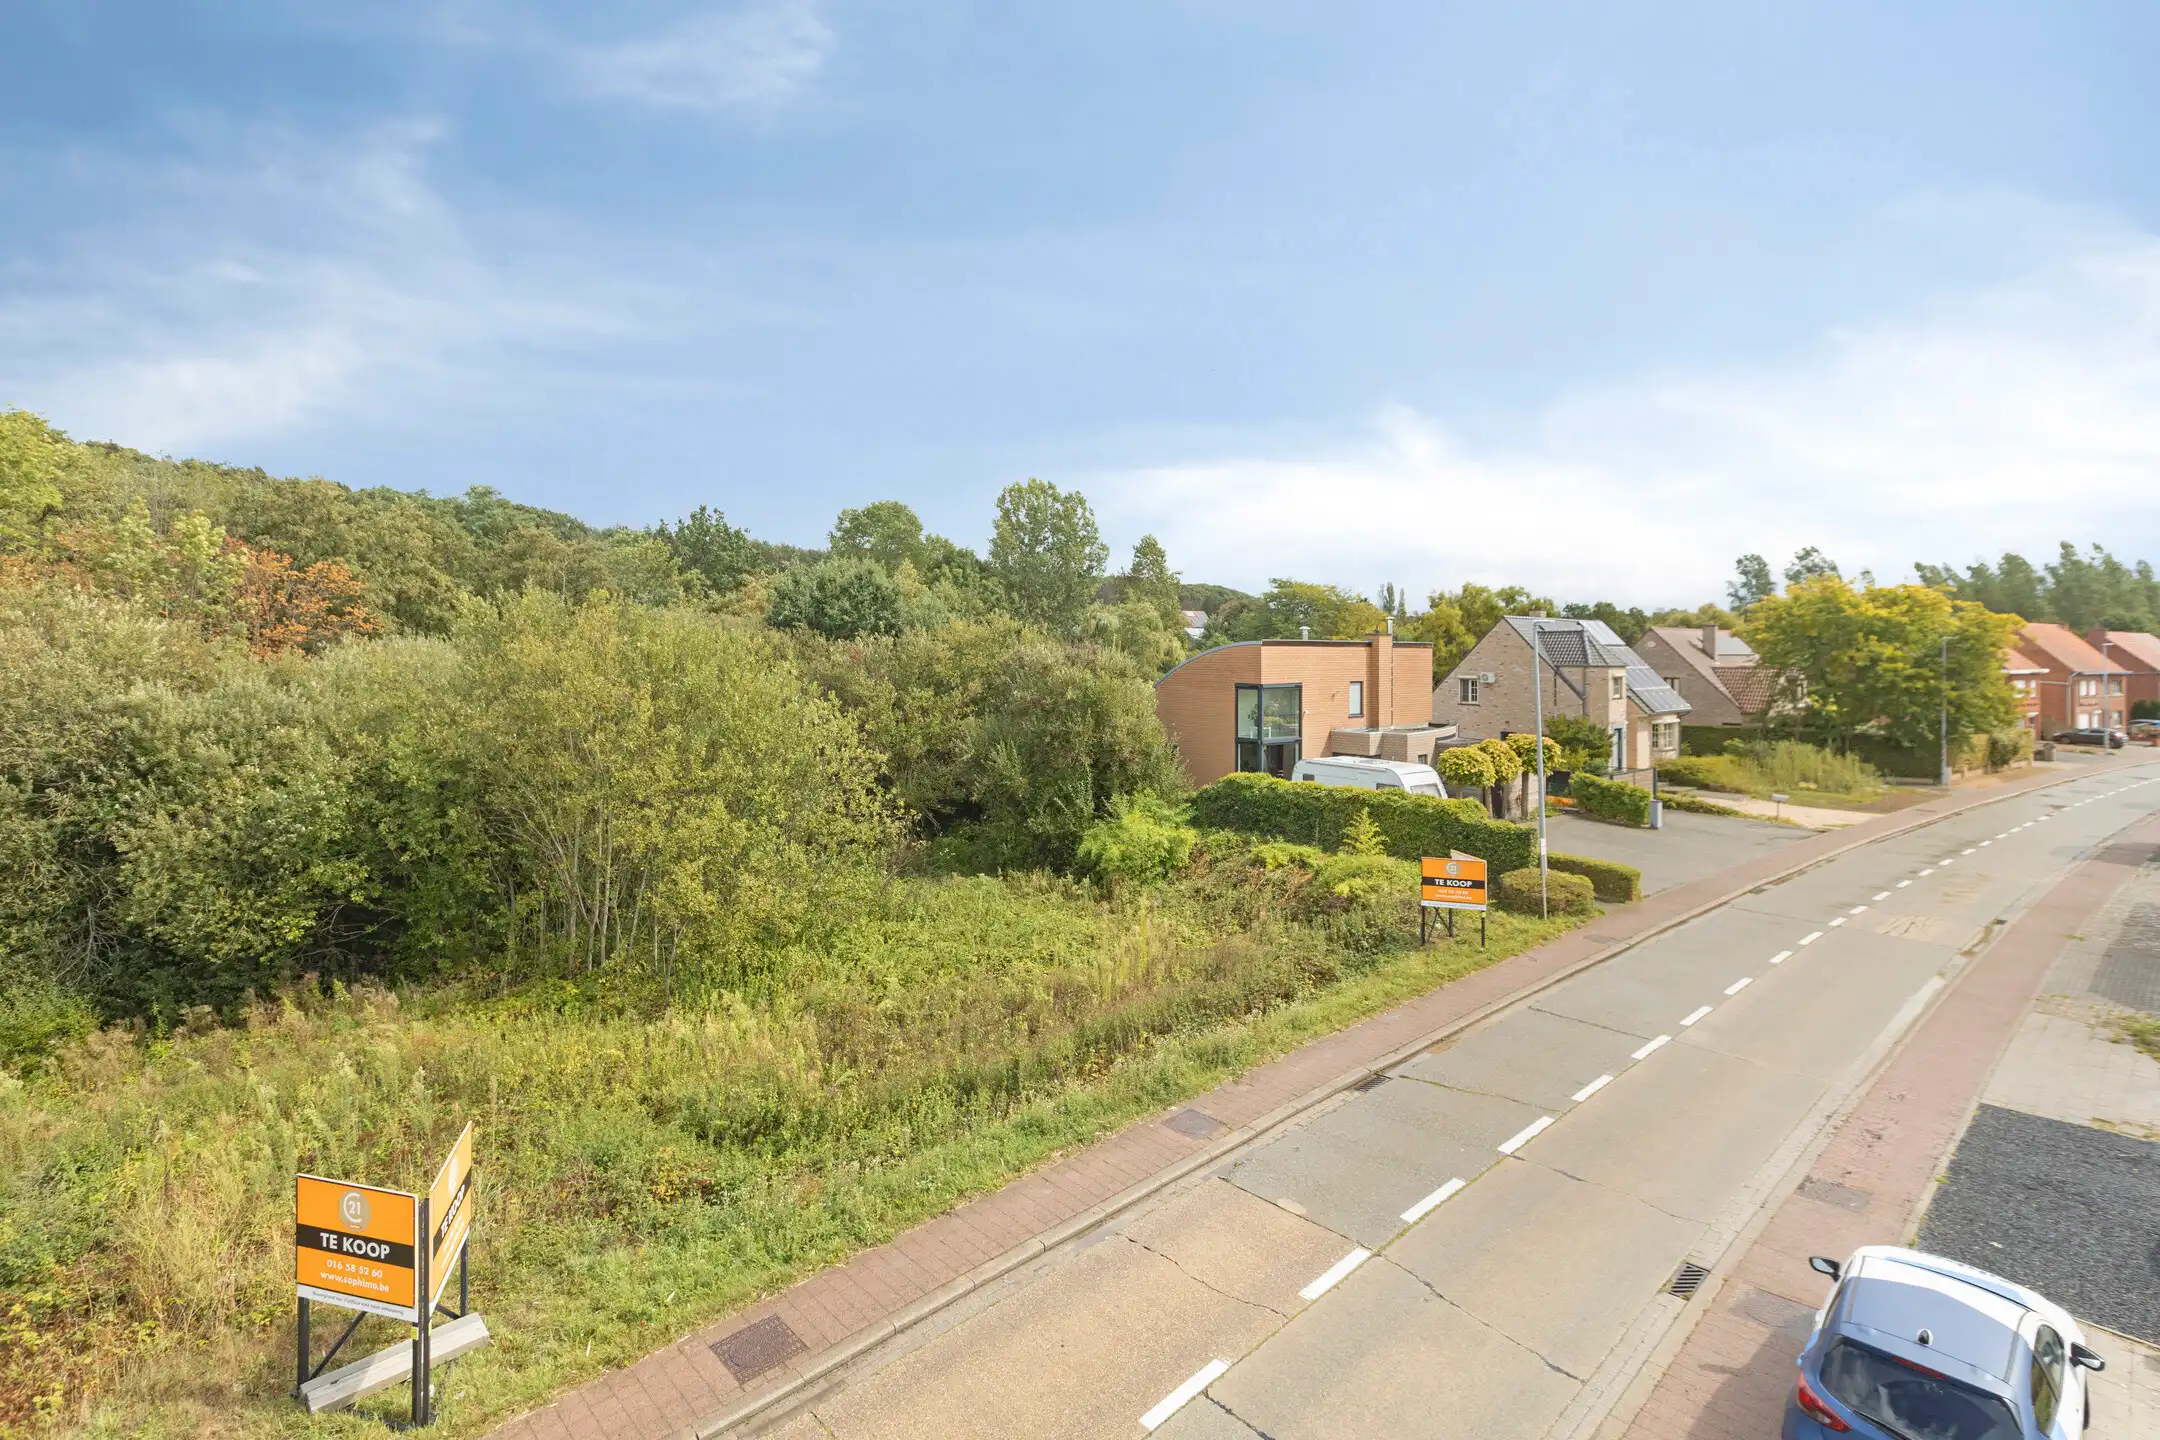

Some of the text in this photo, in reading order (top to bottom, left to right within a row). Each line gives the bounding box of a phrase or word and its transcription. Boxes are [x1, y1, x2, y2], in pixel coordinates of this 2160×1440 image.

[1446, 879, 1472, 887] KOOP
[320, 1232, 390, 1259] TE KOOP
[326, 1259, 343, 1270] 016
[345, 1263, 356, 1273] 58
[359, 1266, 369, 1276] 52
[320, 1271, 389, 1292] www.sophimo.be
